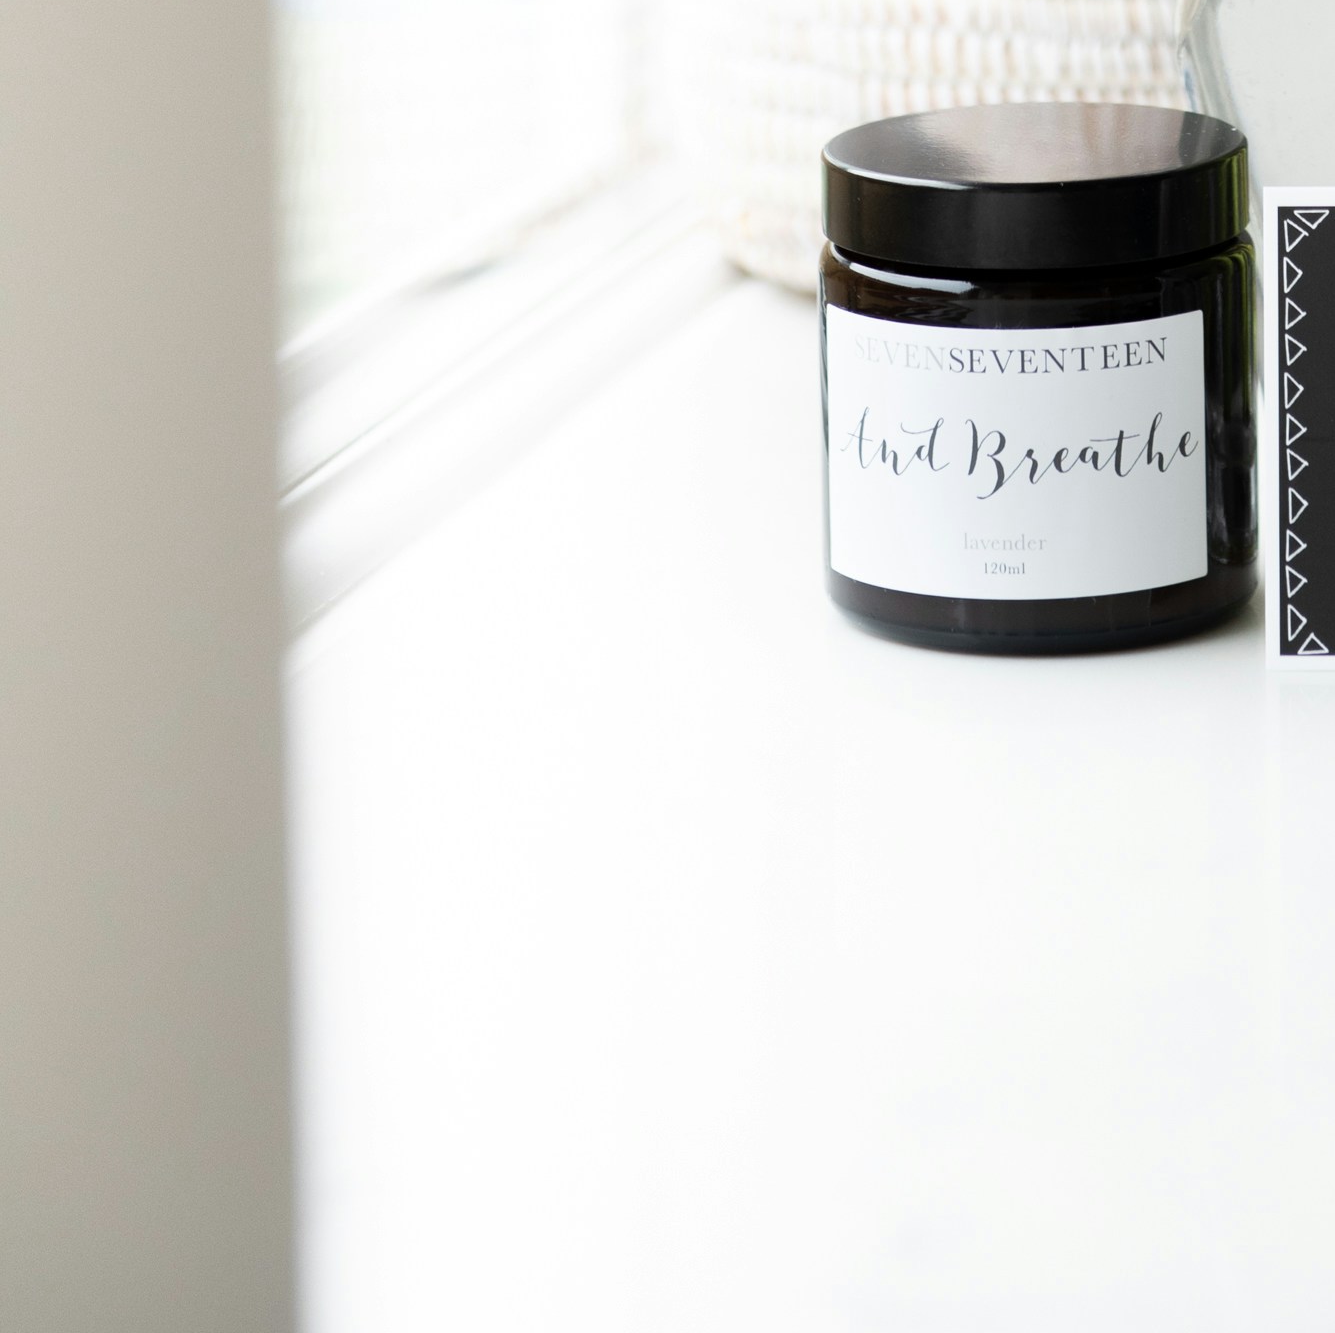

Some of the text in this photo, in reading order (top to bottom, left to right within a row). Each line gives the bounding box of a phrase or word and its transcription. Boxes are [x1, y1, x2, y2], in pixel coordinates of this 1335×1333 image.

[840, 405, 1199, 500] And Breathe
[963, 533, 1047, 552] lavender
[983, 562, 1026, 575] 120ml
